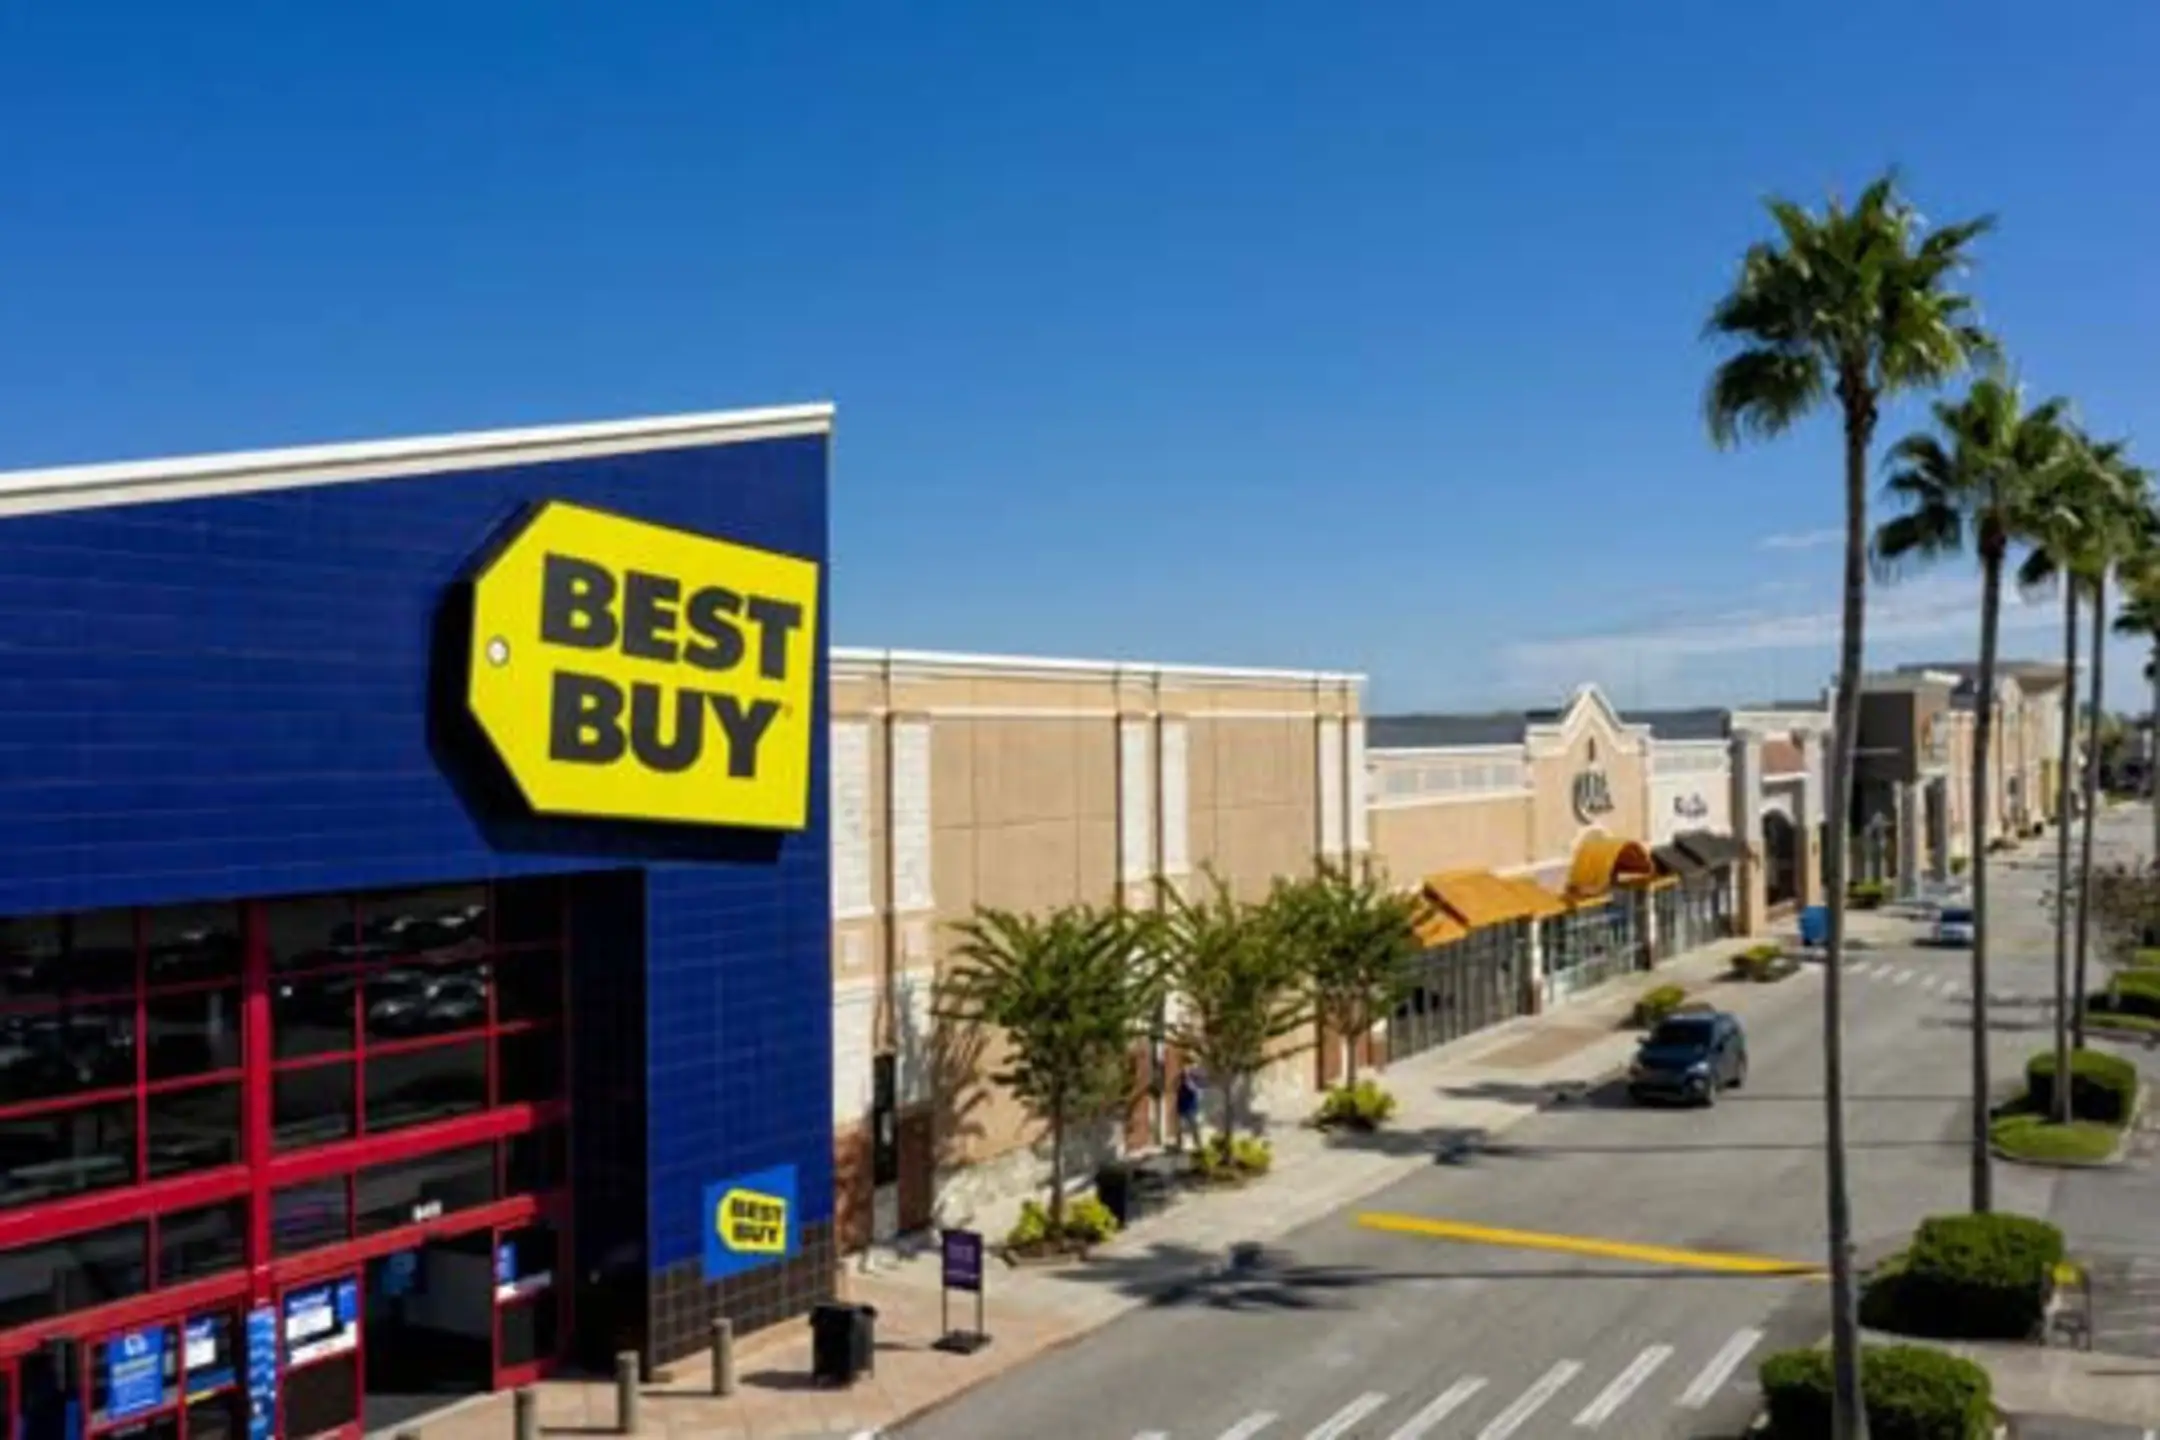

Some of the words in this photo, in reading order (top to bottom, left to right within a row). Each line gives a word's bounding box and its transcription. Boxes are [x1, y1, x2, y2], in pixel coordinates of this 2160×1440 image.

[540, 551, 803, 681] BEST
[549, 669, 782, 778] BUY
[731, 1197, 782, 1222] BEST
[733, 1222, 779, 1243] BUY
